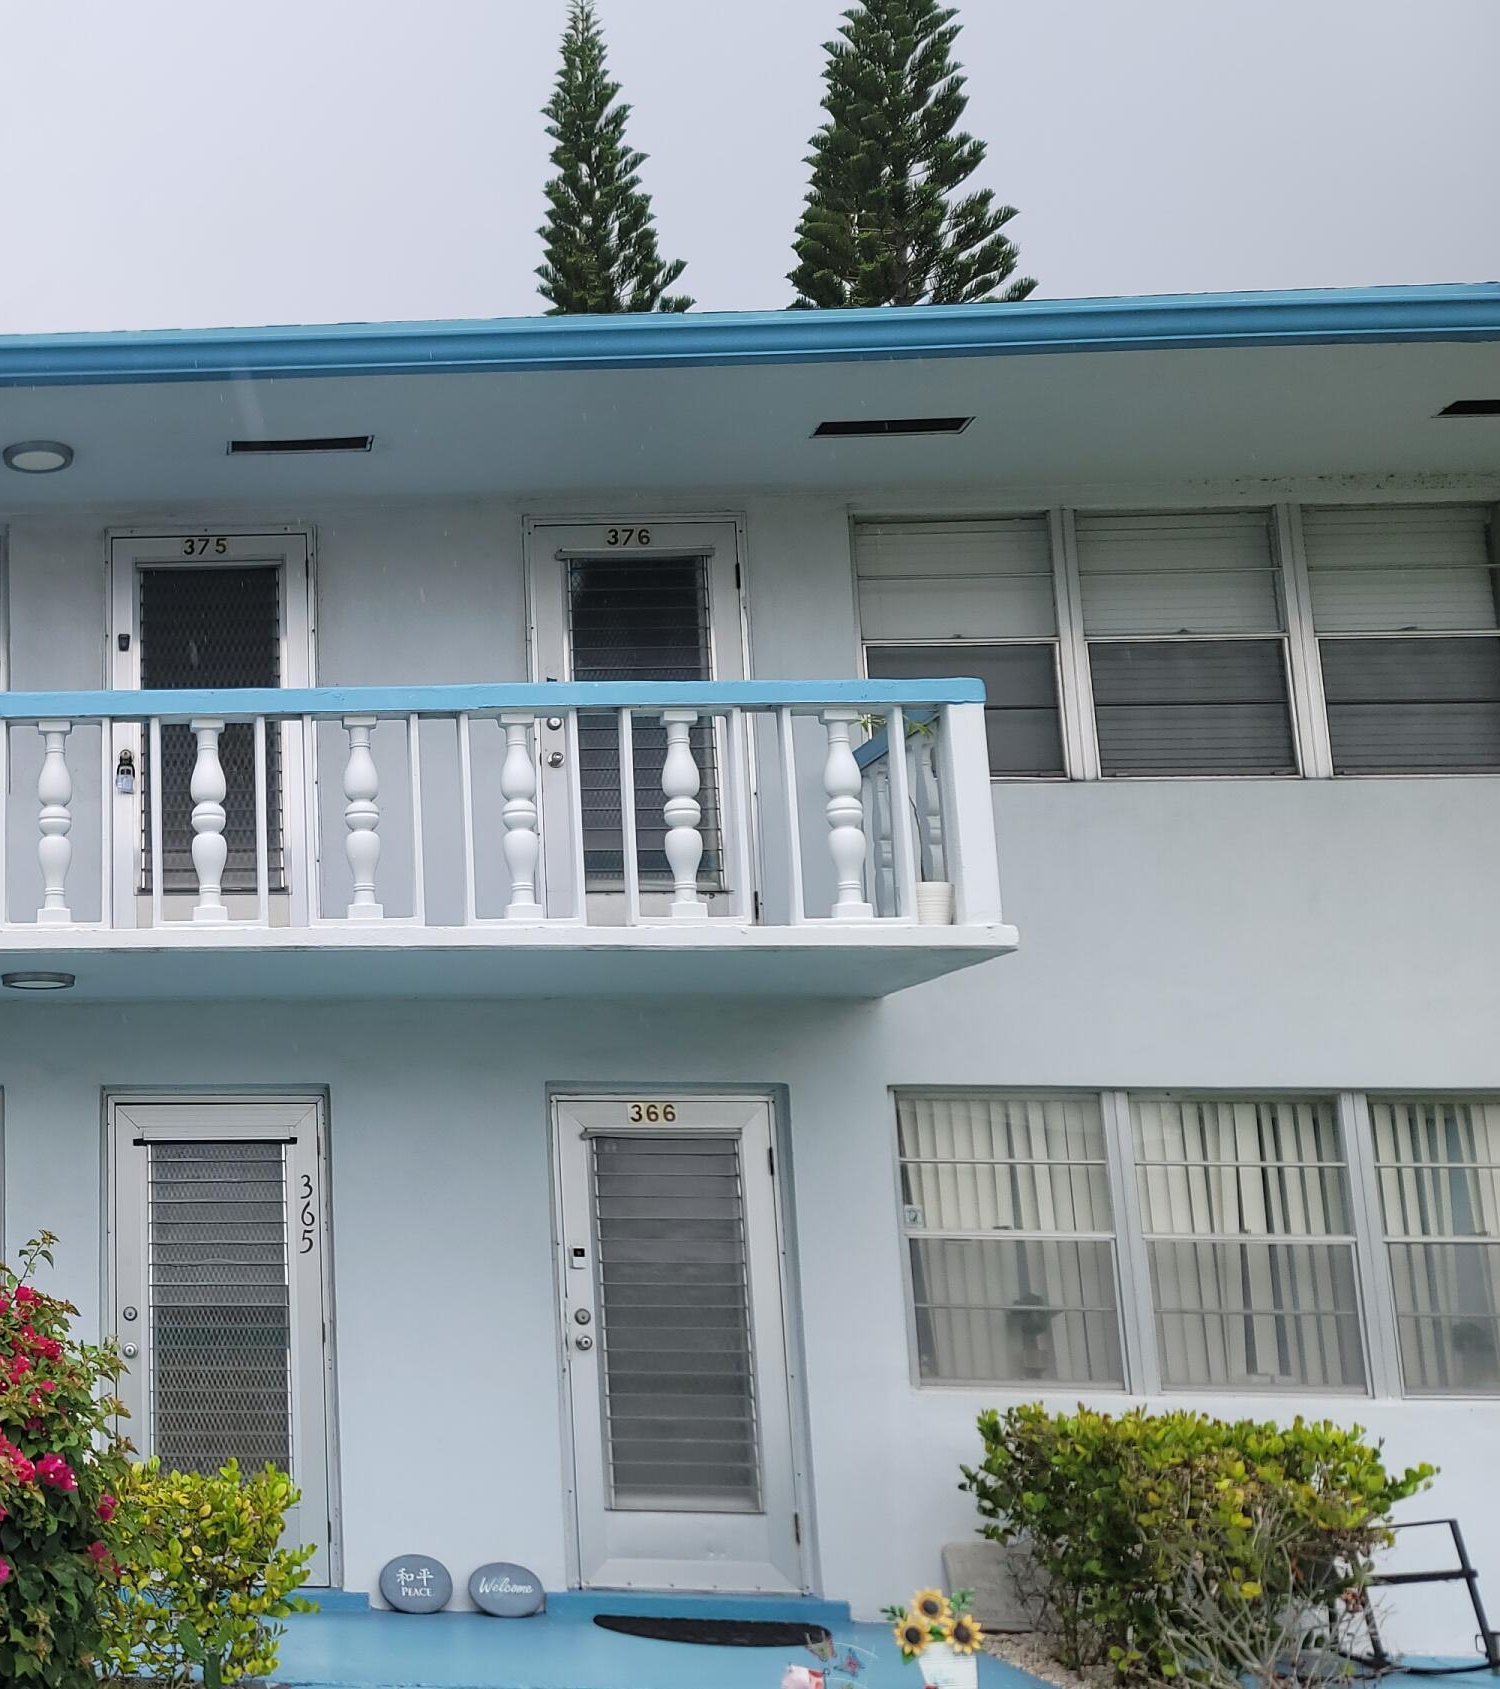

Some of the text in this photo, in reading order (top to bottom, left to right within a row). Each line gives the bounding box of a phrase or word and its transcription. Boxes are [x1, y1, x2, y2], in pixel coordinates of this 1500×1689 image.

[606, 528, 651, 546] 376
[183, 538, 227, 555] 375
[630, 1104, 676, 1122] 366
[299, 1174, 315, 1254] 365
[396, 1567, 434, 1587] 和平
[479, 1576, 534, 1594] Welcome
[401, 1586, 434, 1597] PEACE
